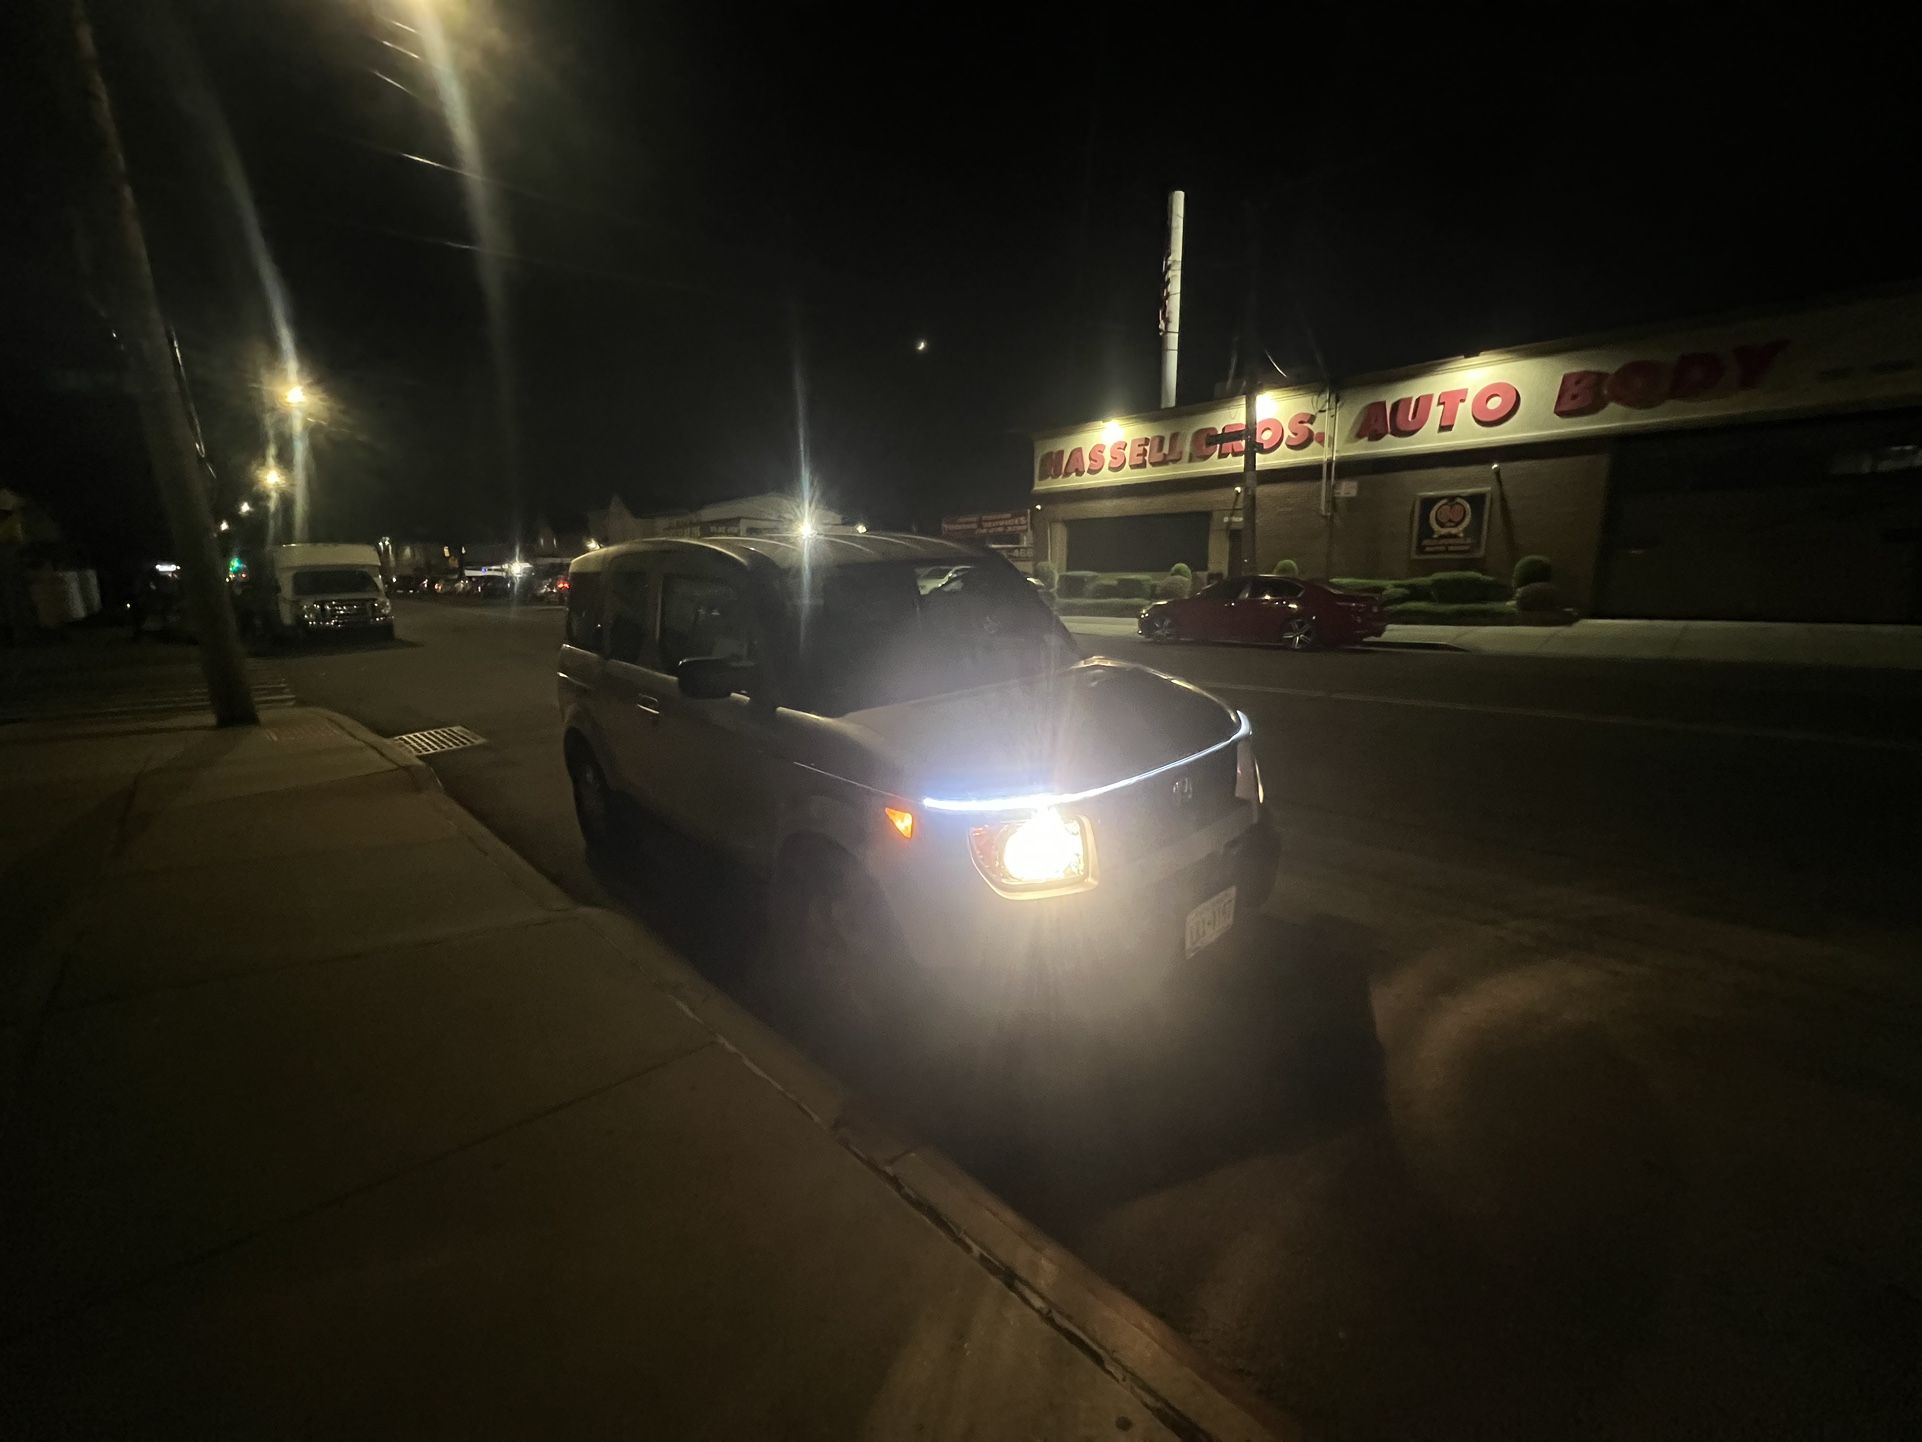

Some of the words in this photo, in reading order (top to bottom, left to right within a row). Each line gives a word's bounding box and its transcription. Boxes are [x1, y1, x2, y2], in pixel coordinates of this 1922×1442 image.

[1038, 431, 1183, 482] HASSELL
[1356, 381, 1521, 441] AUTO
[1554, 339, 1792, 418] BODY
